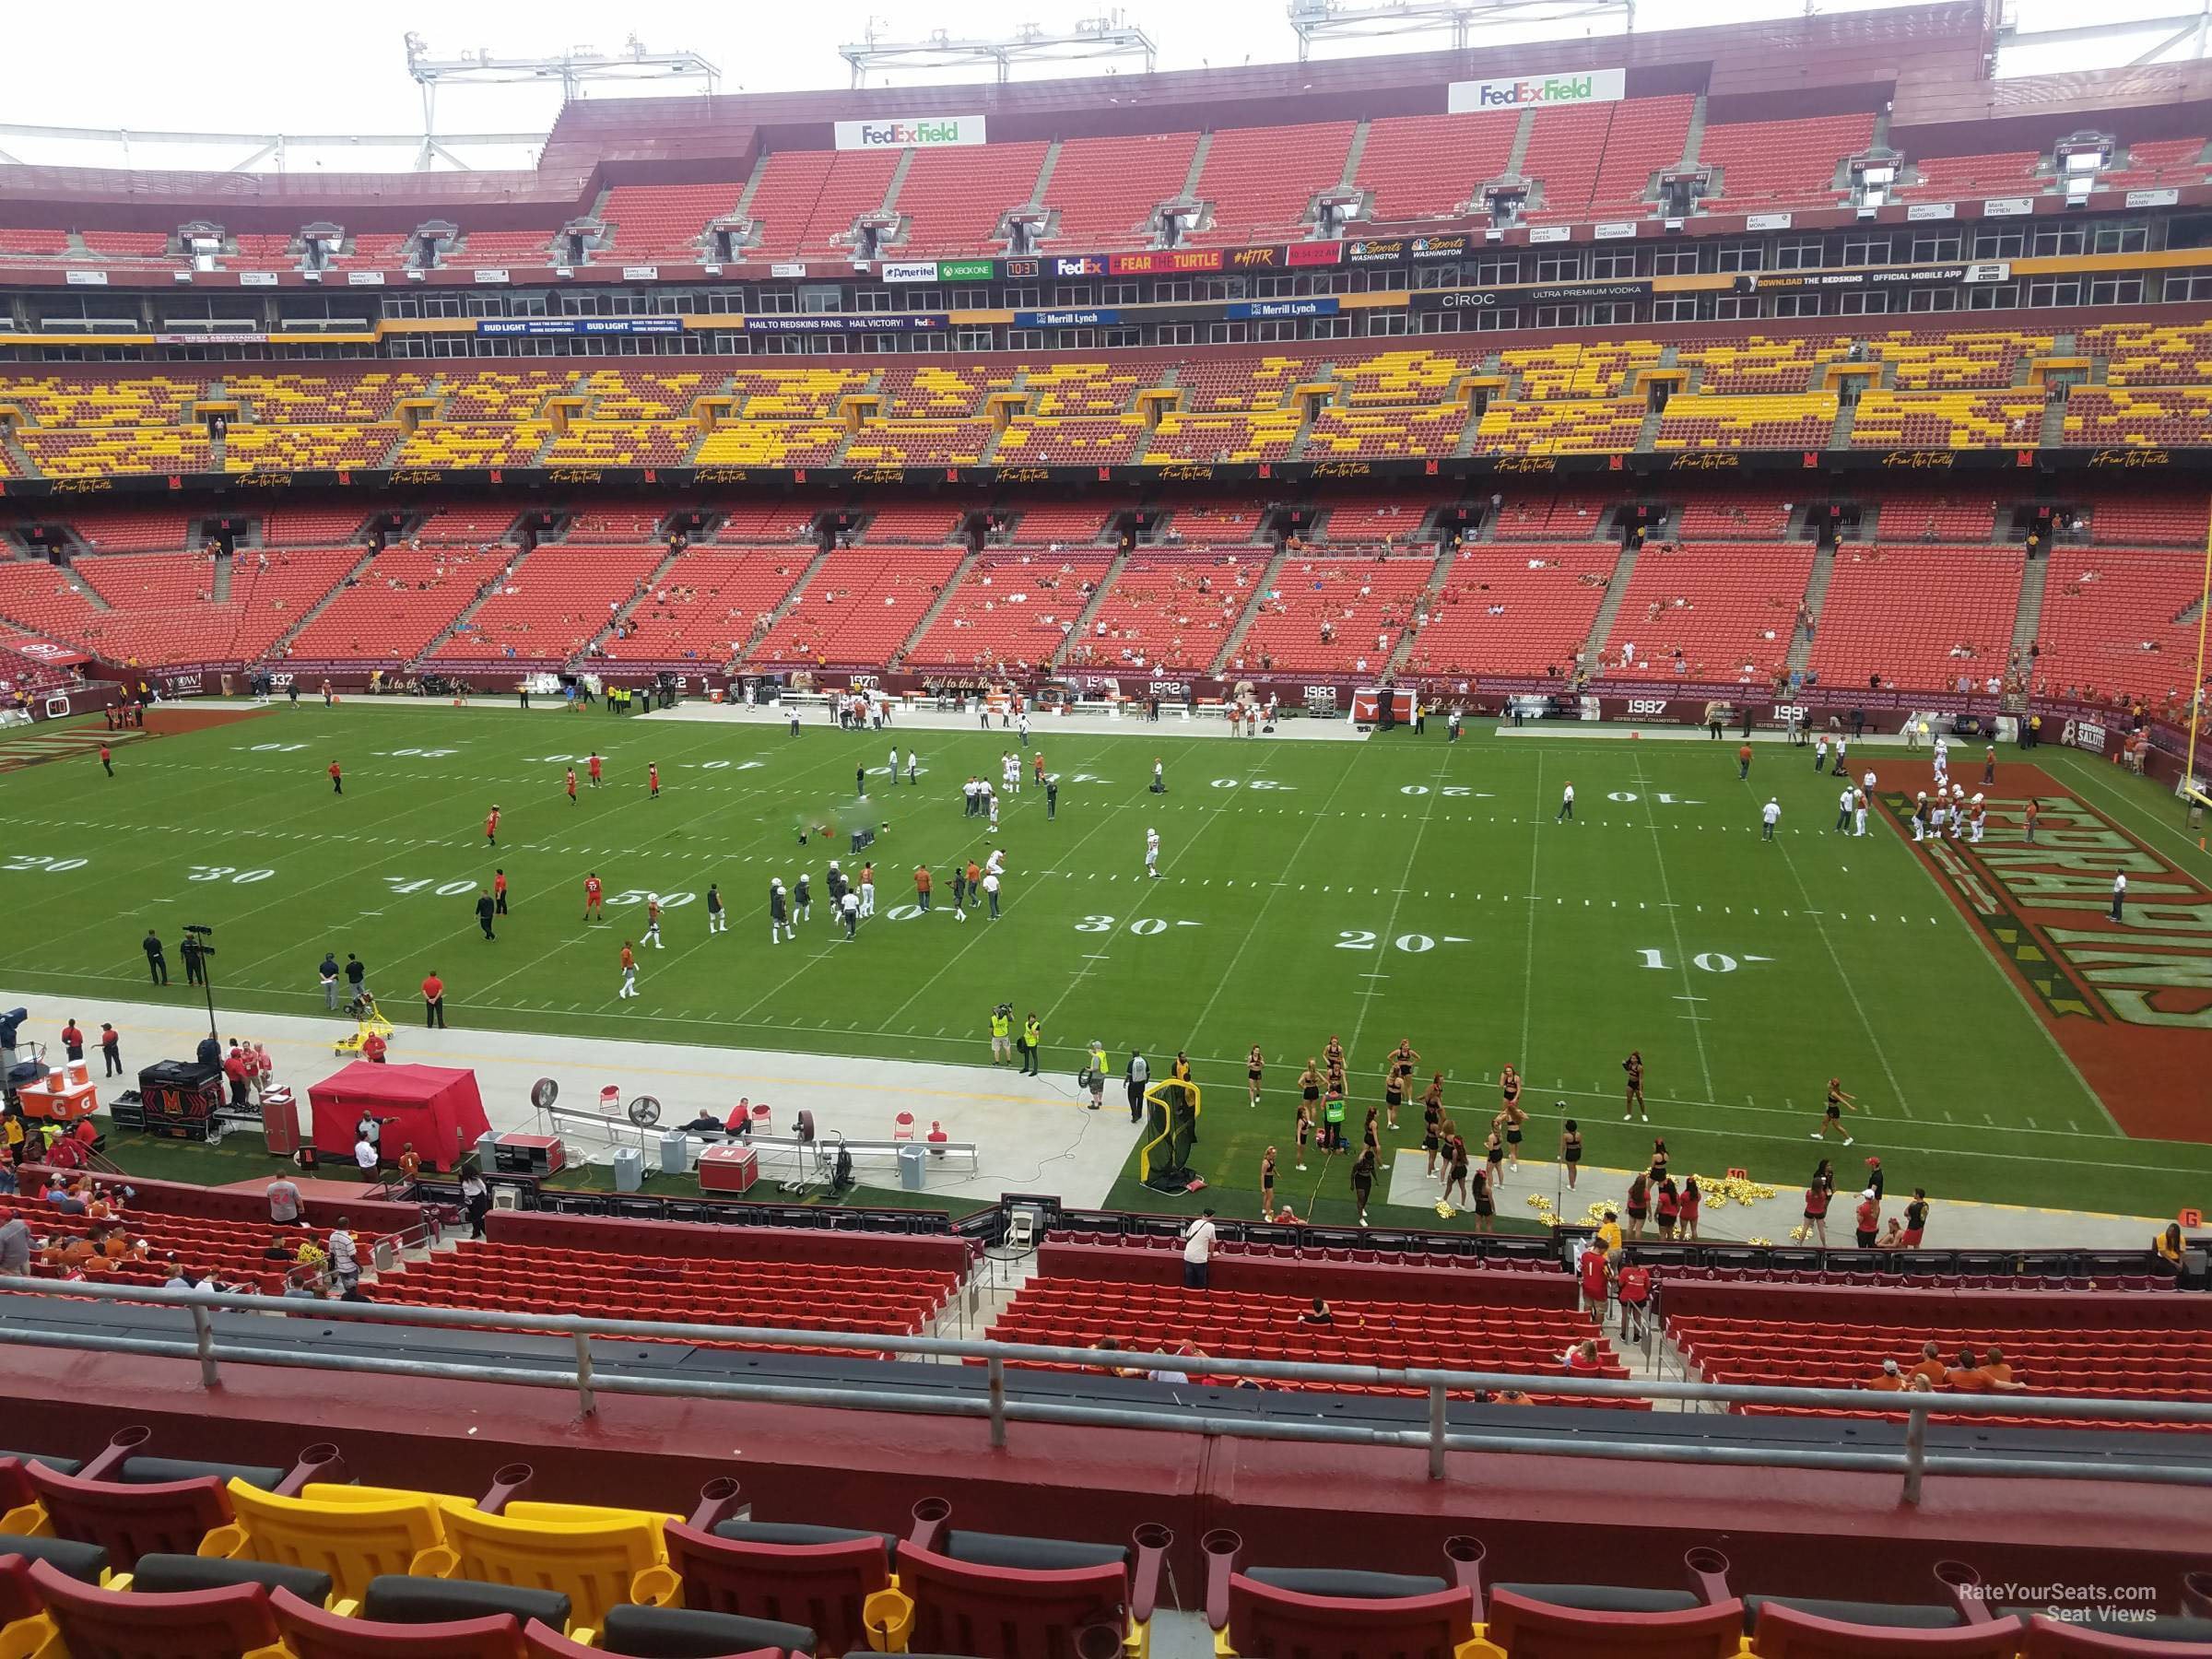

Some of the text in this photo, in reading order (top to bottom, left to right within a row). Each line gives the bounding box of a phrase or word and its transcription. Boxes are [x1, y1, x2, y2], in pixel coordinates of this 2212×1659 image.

[1480, 76, 1592, 106] FedExField
[863, 122, 959, 145] FedExField
[1366, 241, 1402, 254] Sports
[1428, 238, 1465, 251] Sports
[894, 267, 935, 277] Ameritel
[1057, 259, 1102, 275] FedEx
[1758, 269, 1961, 288] DOWNLOAD THE REDSKINS OFFICIAL MOBILE APP
[1533, 288, 1560, 299] ULTRA
[1563, 287, 1606, 296] PREMIUM
[1608, 286, 1641, 295] VODKA
[1263, 303, 1315, 315] Merrill Lynch
[606, 322, 629, 330] LIGHT
[749, 318, 935, 329] HAIL TO REDSKINS FANS. HAIL VICTORY! FedEx
[1047, 312, 1098, 325] Merrill Lynch
[959, 676, 974, 688] the
[1303, 686, 1336, 699] 1983
[1628, 700, 1667, 714] 1987
[2077, 729, 2105, 748] SALUTE
[188, 866, 275, 884] 30
[390, 878, 477, 896] 40
[1074, 915, 1168, 935] 30
[1334, 930, 1436, 952] 20
[1636, 948, 1737, 972] 10
[52, 1099, 66, 1116] G
[81, 1096, 90, 1109] G
[161, 1089, 184, 1115] M
[2186, 1211, 2198, 1227] G
